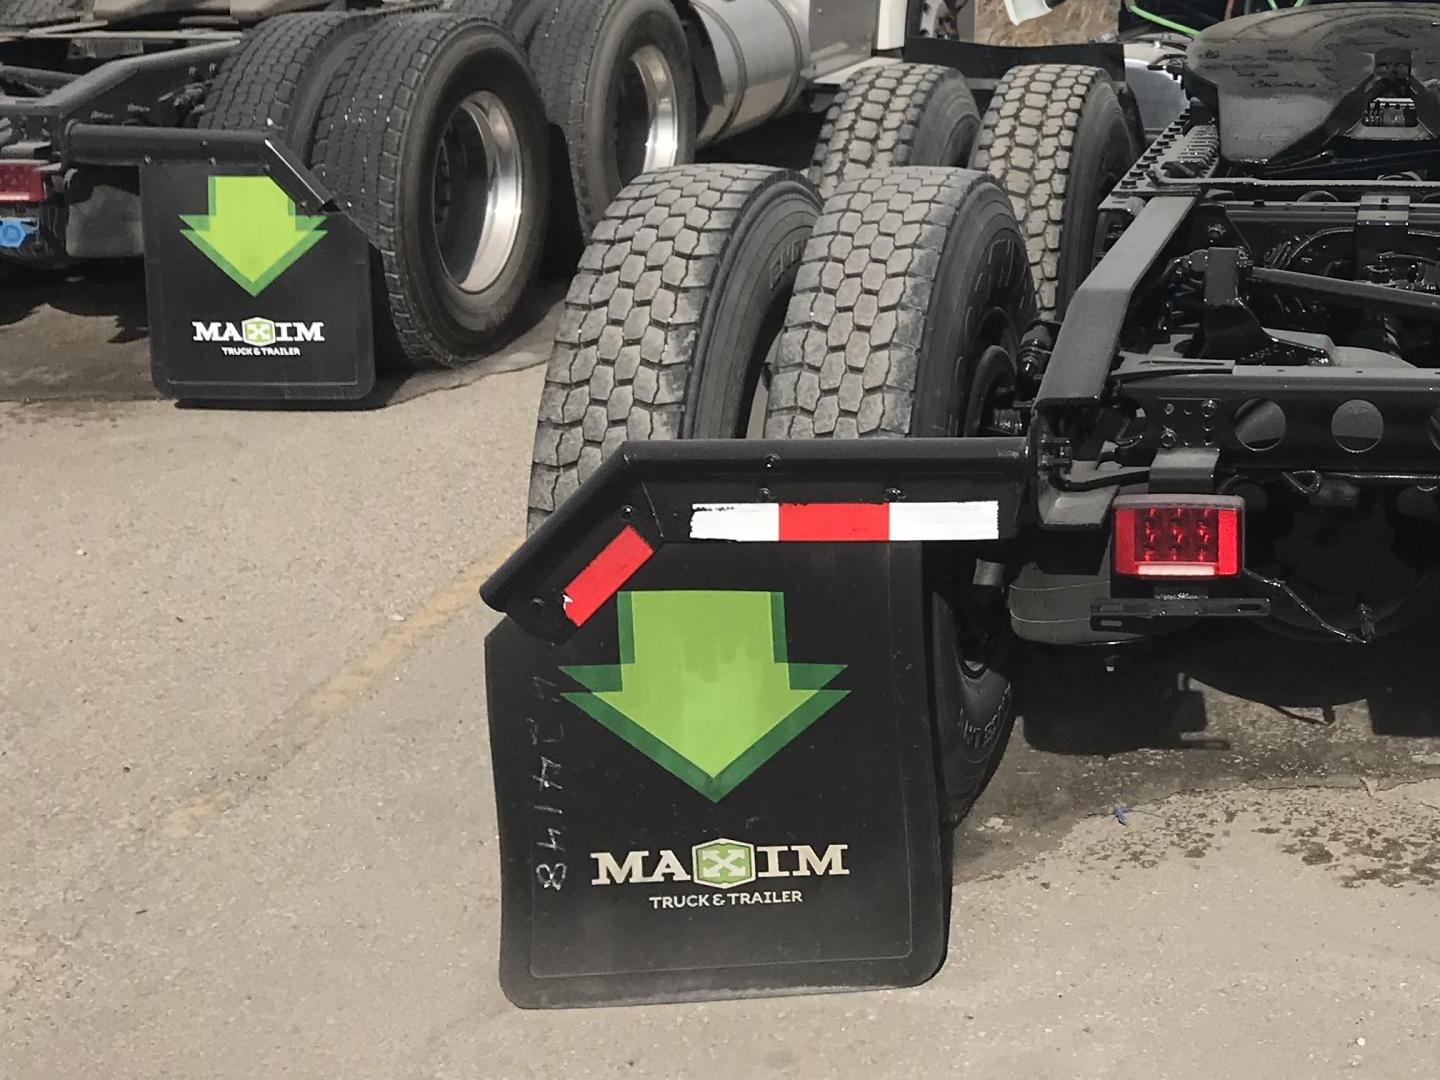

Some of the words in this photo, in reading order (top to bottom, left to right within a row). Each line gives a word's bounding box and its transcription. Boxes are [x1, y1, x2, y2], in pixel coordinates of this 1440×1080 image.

[191, 316, 326, 347] MAXIM
[221, 346, 253, 356] TRUCK
[261, 346, 301, 356] TRAILER
[590, 837, 851, 890] MAXIM
[648, 893, 710, 910] TRUCK
[712, 893, 726, 906] &
[726, 890, 804, 906] TRAILER
